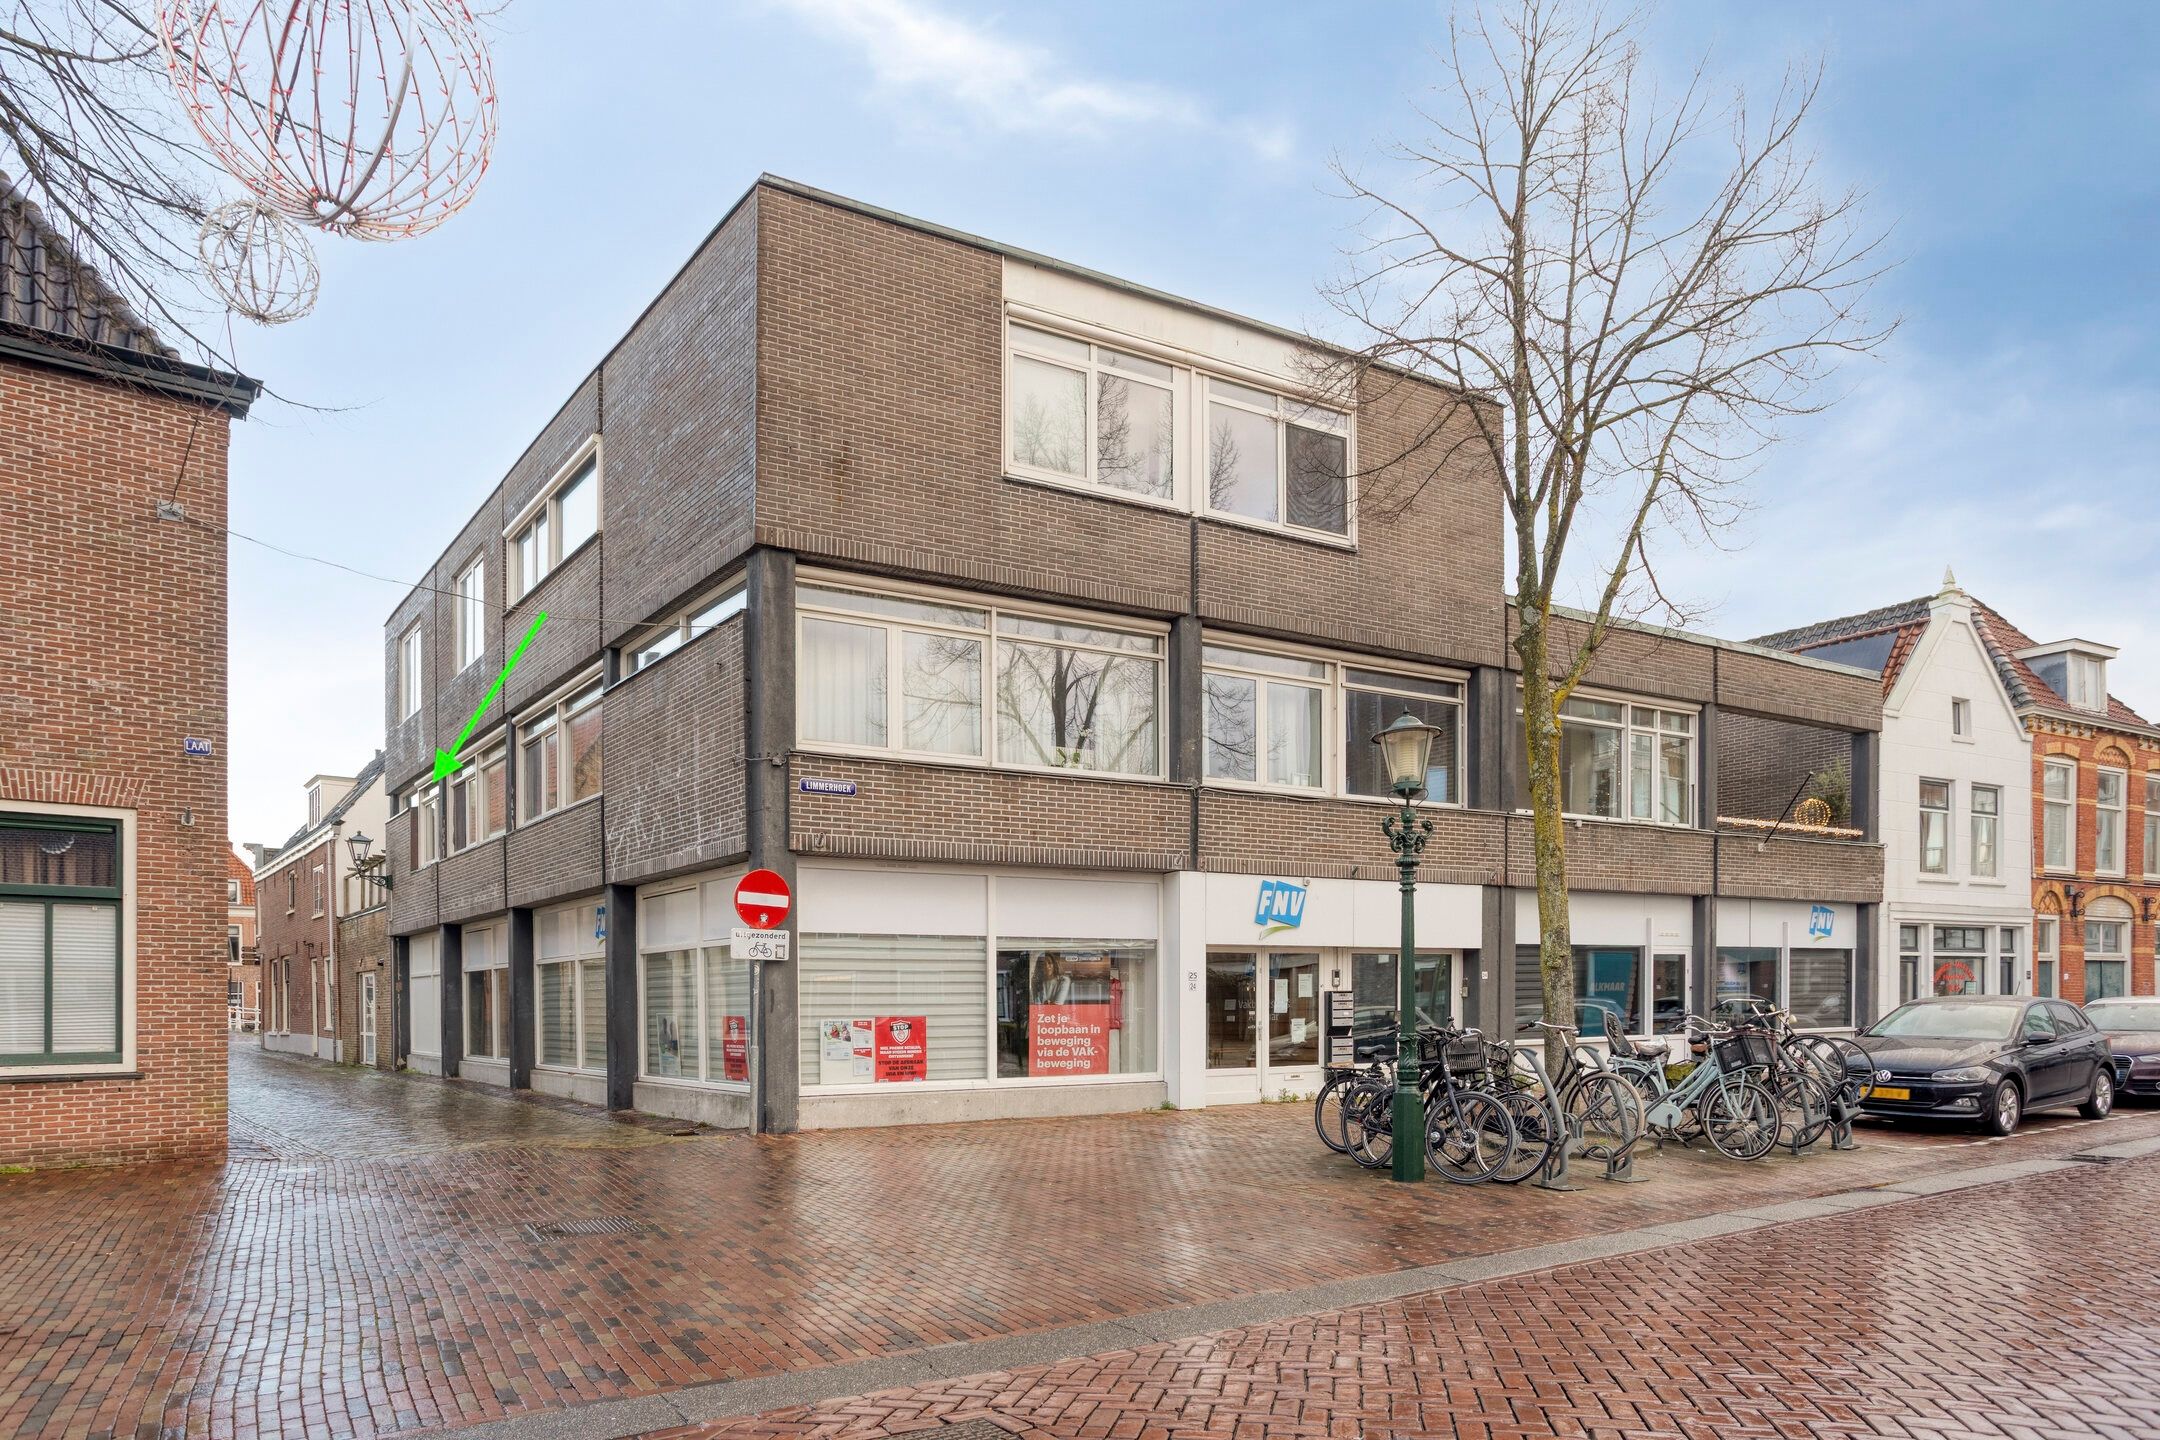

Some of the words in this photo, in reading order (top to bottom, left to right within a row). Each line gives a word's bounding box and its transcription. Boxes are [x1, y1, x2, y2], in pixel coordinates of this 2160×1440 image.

[185, 740, 210, 752] LAAT
[806, 781, 851, 793] LIMMERHOEK
[1258, 890, 1305, 917] FNV
[1810, 912, 1834, 930] FNV
[735, 931, 786, 940] utgezonderd
[1188, 971, 1198, 980] 25
[1590, 982, 1626, 992] ALKMAAR
[1037, 1013, 1056, 1023] Zet
[1057, 1014, 1068, 1024] je
[1037, 1025, 1088, 1035] loopbaan
[1090, 1024, 1101, 1034] in
[1037, 1036, 1091, 1047] beweging
[1037, 1048, 1054, 1057] via
[1055, 1047, 1070, 1057] de
[1071, 1046, 1099, 1056] VAK-
[1037, 1058, 1091, 1069] beweging
